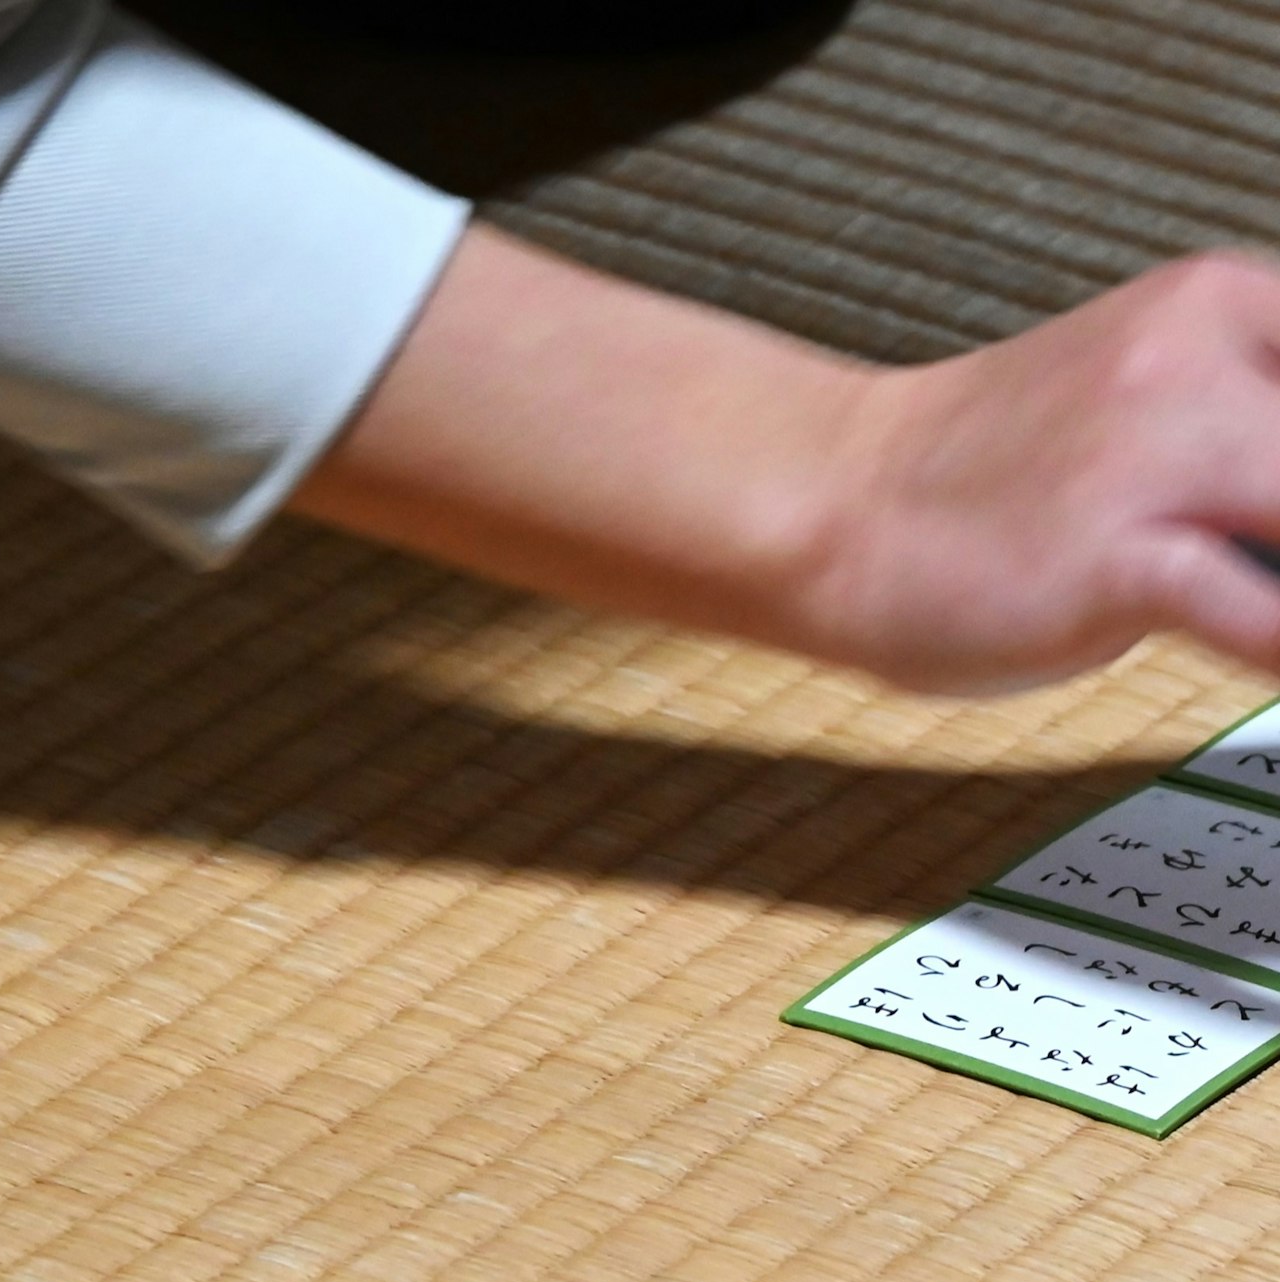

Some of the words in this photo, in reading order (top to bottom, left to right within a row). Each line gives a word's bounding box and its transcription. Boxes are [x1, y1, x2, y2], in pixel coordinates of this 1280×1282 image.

[915, 955, 1208, 1059] かにしるひ
[1023, 942, 1268, 1022] ともなし
[849, 987, 1158, 1097] はなよりほ
